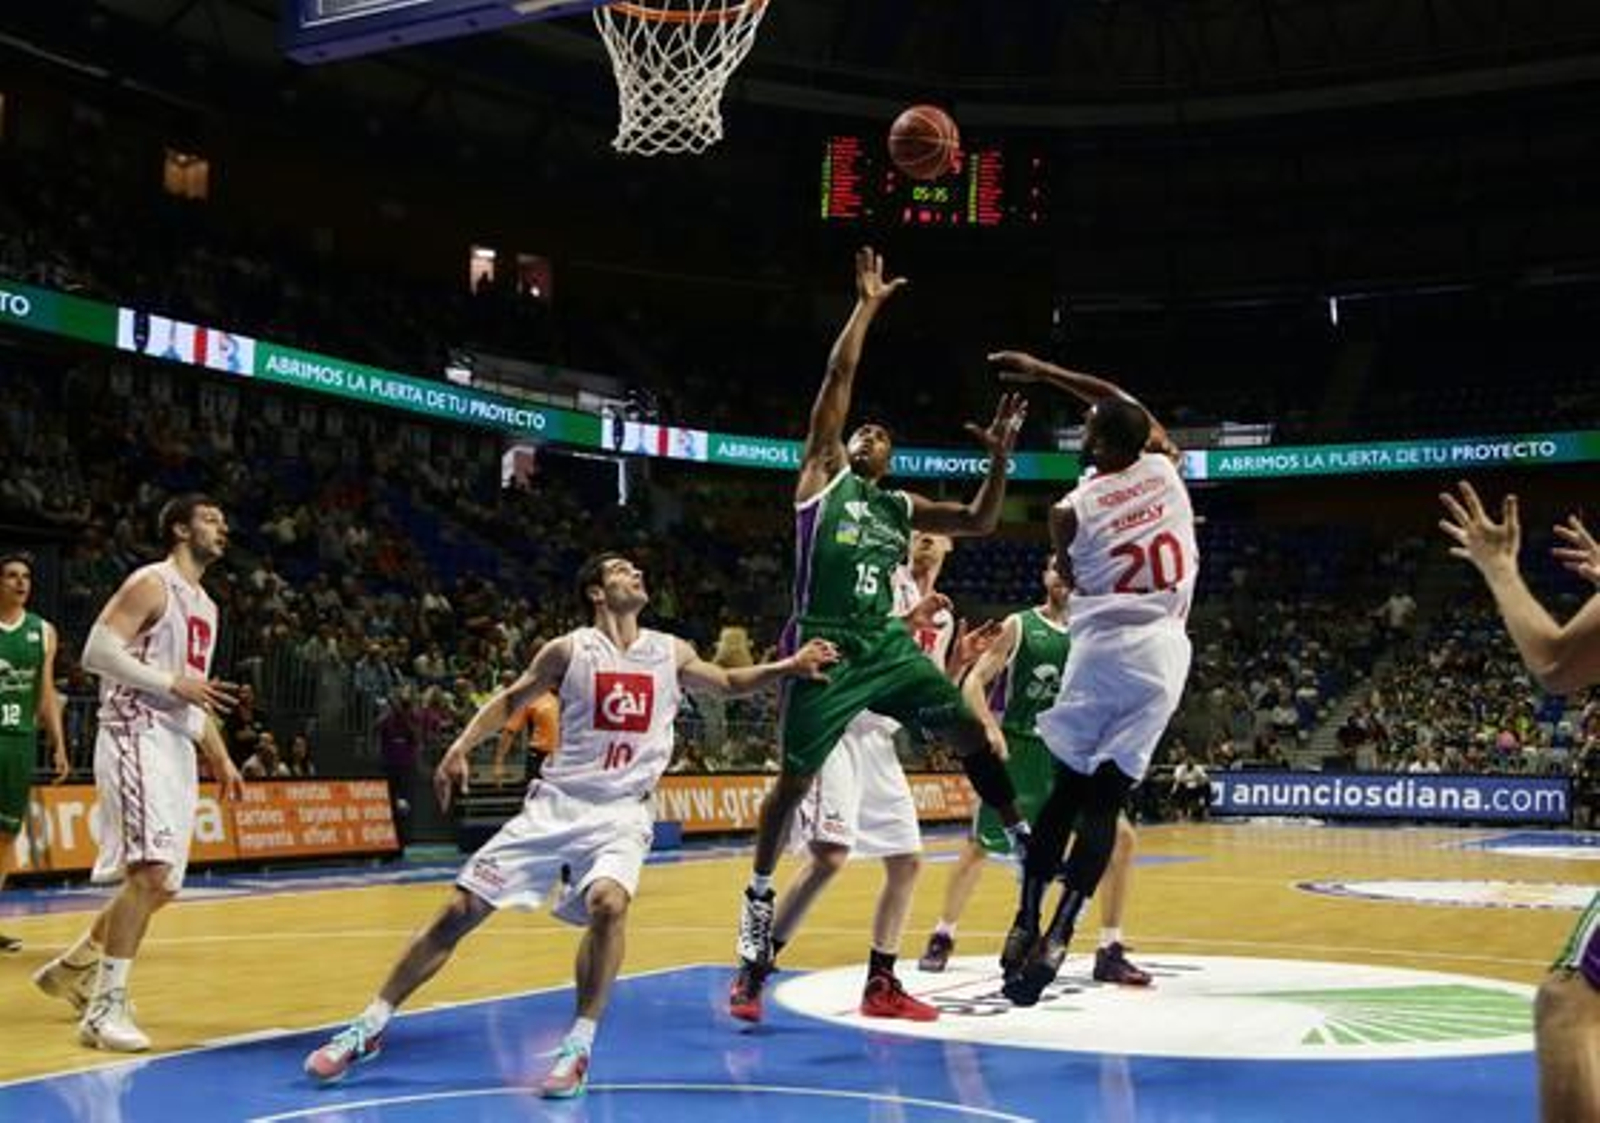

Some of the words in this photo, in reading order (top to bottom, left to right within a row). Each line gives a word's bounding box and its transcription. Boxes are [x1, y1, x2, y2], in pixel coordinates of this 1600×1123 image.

[265, 354, 344, 386] ABRIMOS
[346, 372, 366, 392] LA
[369, 377, 423, 405] PUERTA
[426, 389, 446, 410] DE
[447, 393, 468, 414] TU
[469, 399, 546, 430] PROYECTO
[718, 441, 788, 463] ABRIMOS
[899, 455, 920, 472] TU
[924, 455, 1017, 475] PROYECO
[1219, 454, 1300, 473] ABRIMOS
[1303, 453, 1326, 469] LA
[1329, 450, 1391, 467] PUERTA
[1395, 447, 1419, 464] DE
[1423, 446, 1448, 463] TU
[1452, 440, 1557, 461] PROYECTO
[1108, 530, 1184, 594] 20
[1232, 778, 1566, 813] anunciosdiana.com
